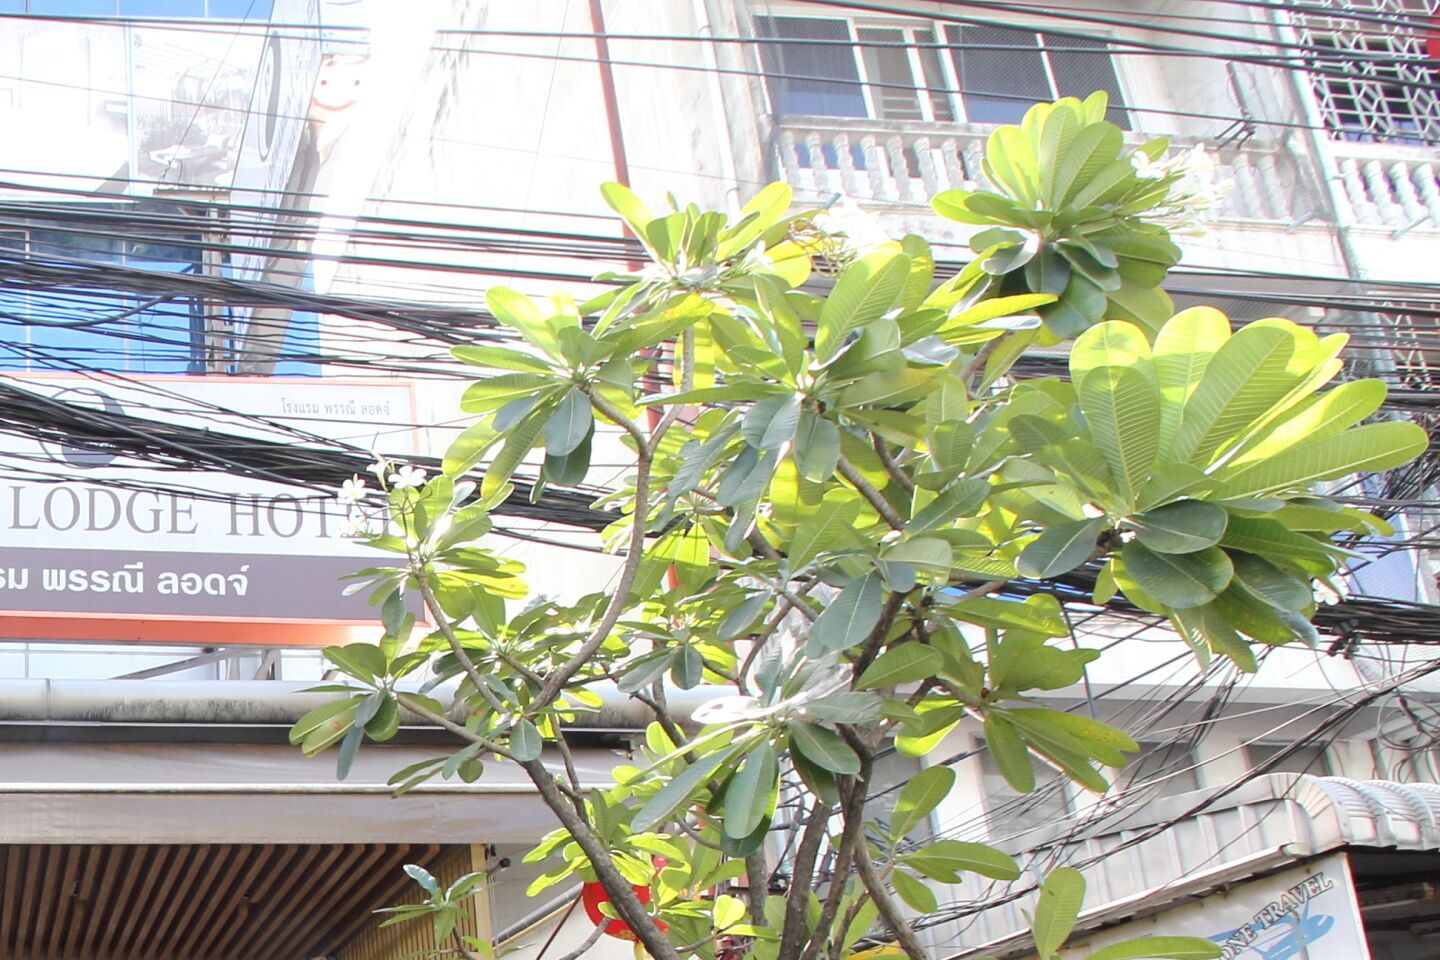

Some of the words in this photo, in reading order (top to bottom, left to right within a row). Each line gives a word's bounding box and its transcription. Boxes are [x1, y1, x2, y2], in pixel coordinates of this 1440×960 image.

[281, 397, 319, 414] โรงแรม
[7, 484, 199, 536] LODGE
[42, 561, 145, 594] พรรณี
[156, 564, 250, 597] ลอดจ์
[1253, 871, 1335, 931] TRAVEL
